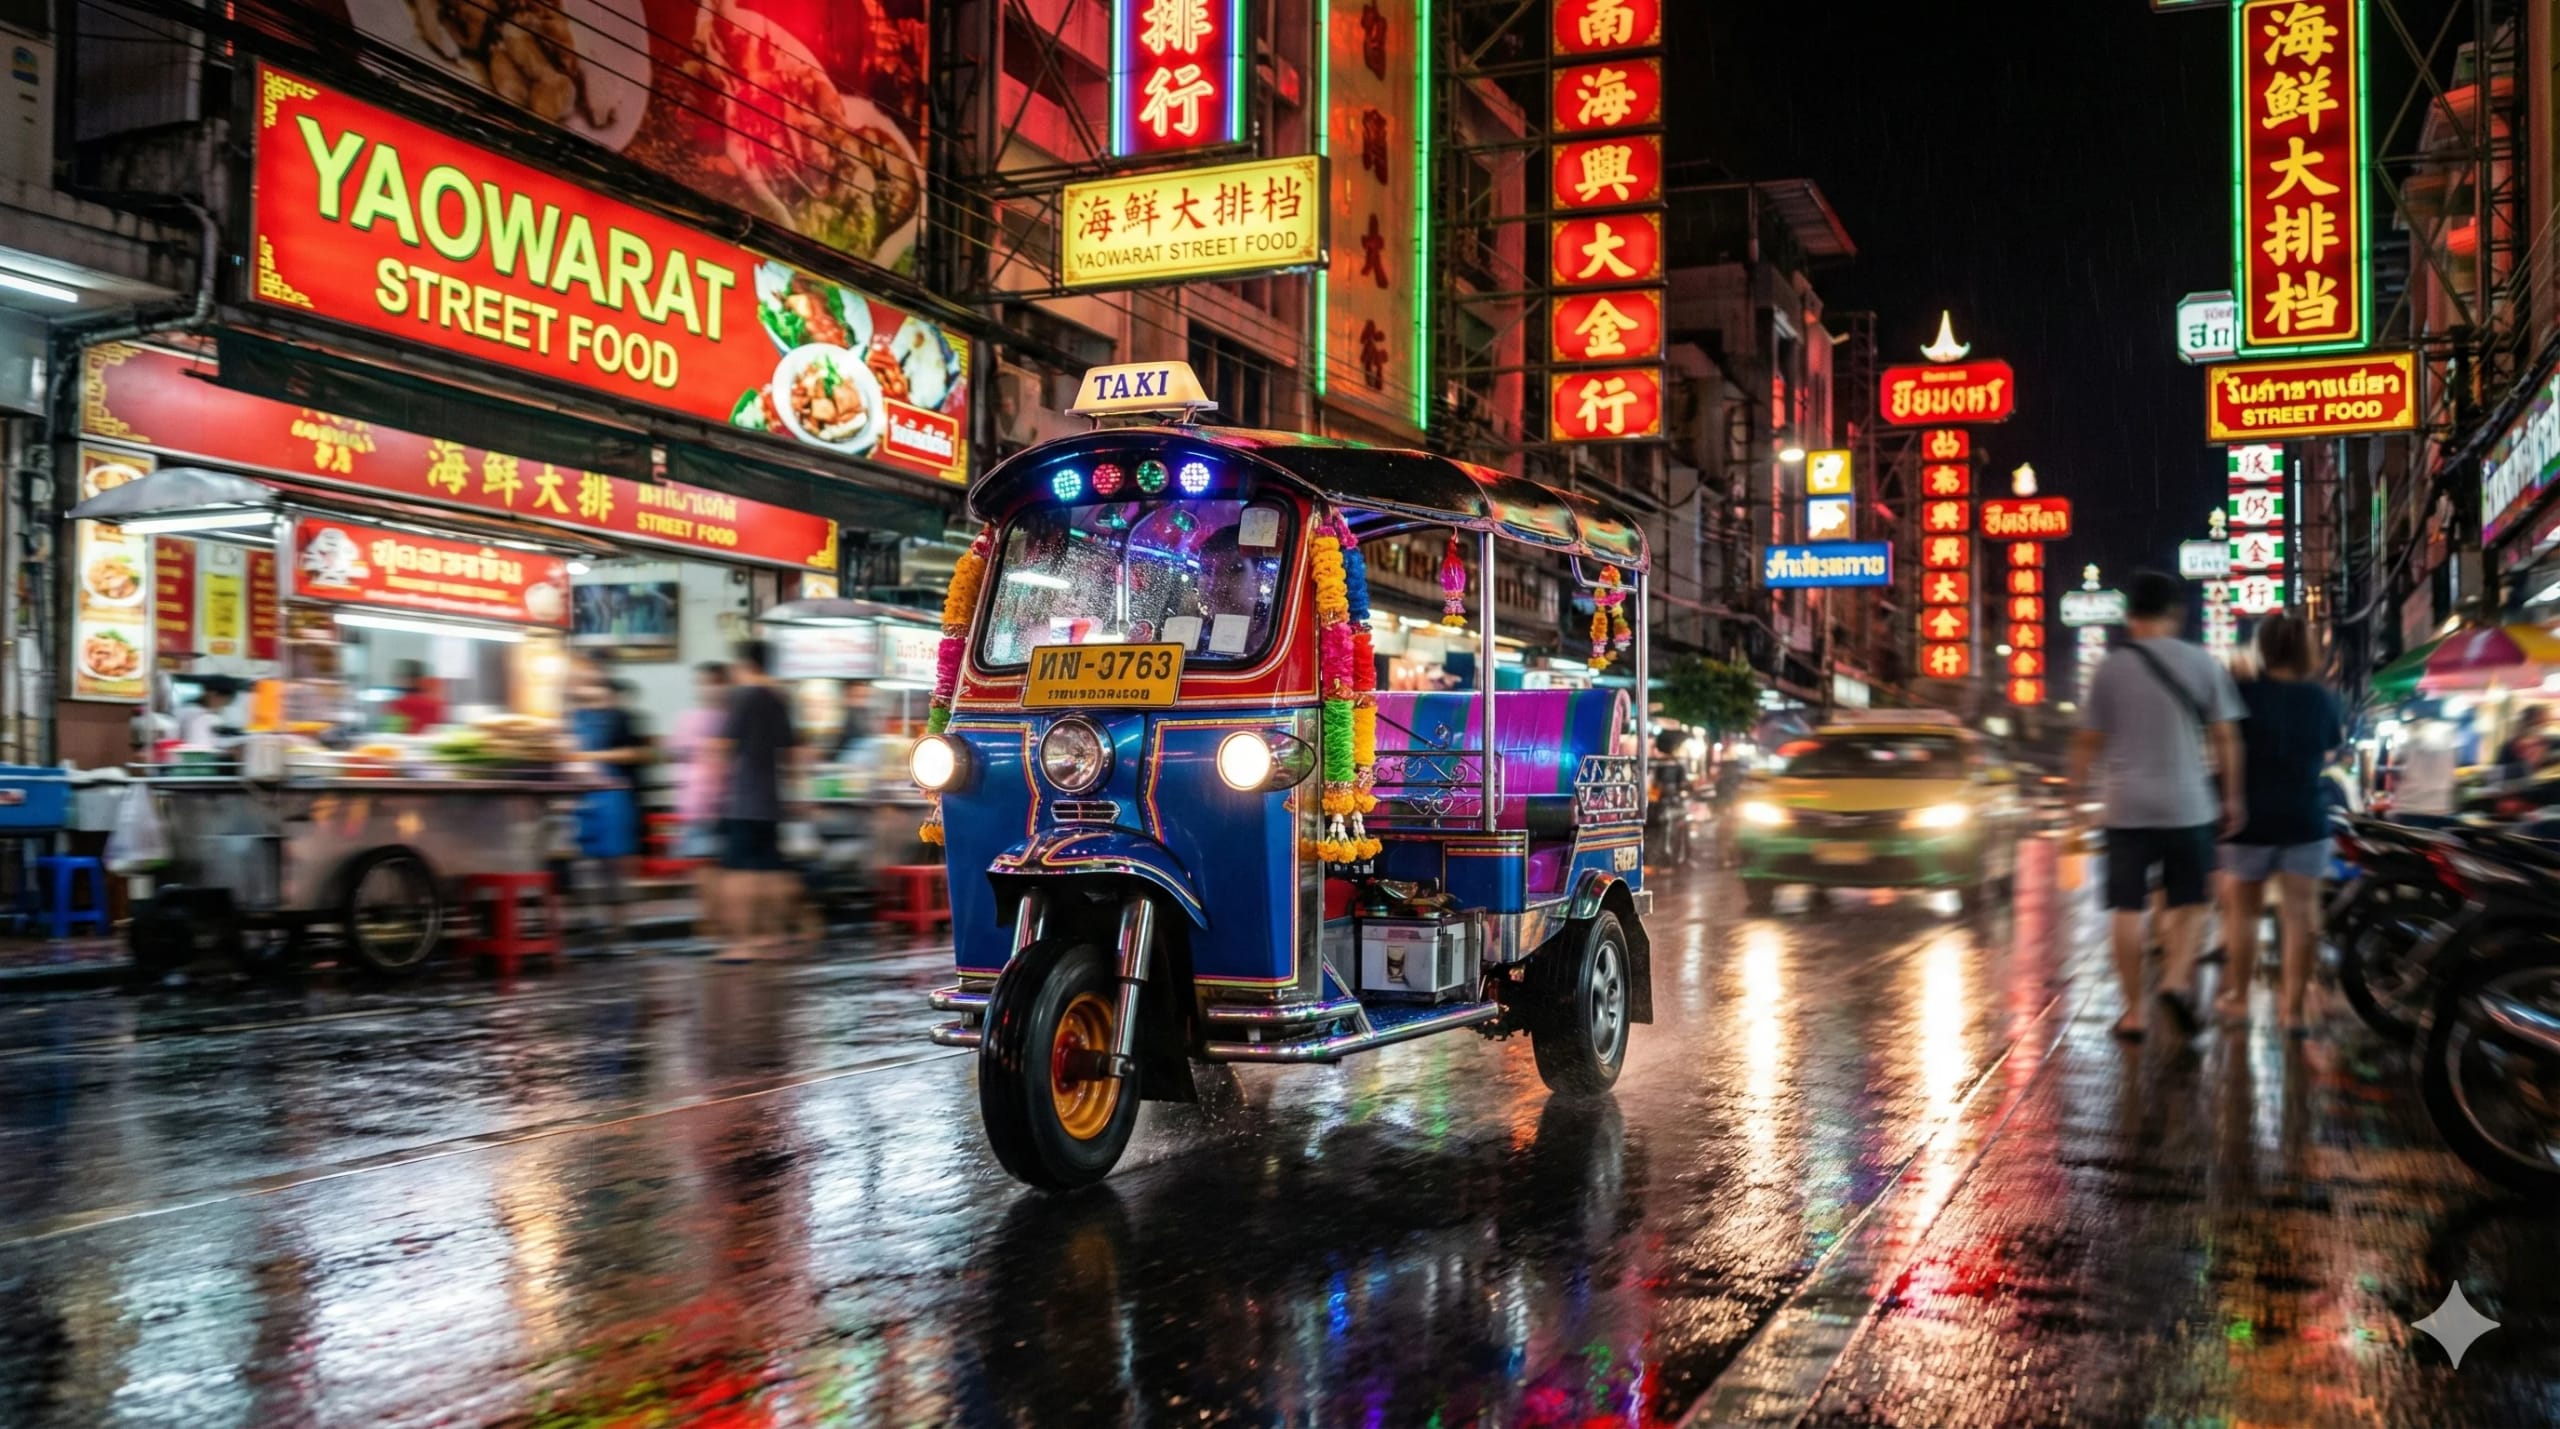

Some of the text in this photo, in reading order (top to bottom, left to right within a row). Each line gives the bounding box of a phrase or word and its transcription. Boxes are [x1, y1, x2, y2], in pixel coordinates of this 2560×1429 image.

[296, 115, 736, 342] YAOWARAT
[1575, 0, 1638, 434] 南海興大金行
[1076, 231, 1298, 270] YAOWARAT STREET FOOD
[375, 257, 680, 389] STREET FOOD
[1094, 370, 1169, 400] TAKI
[2241, 400, 2383, 427] STREET FOOD
[636, 511, 738, 547] STREET FOOD
